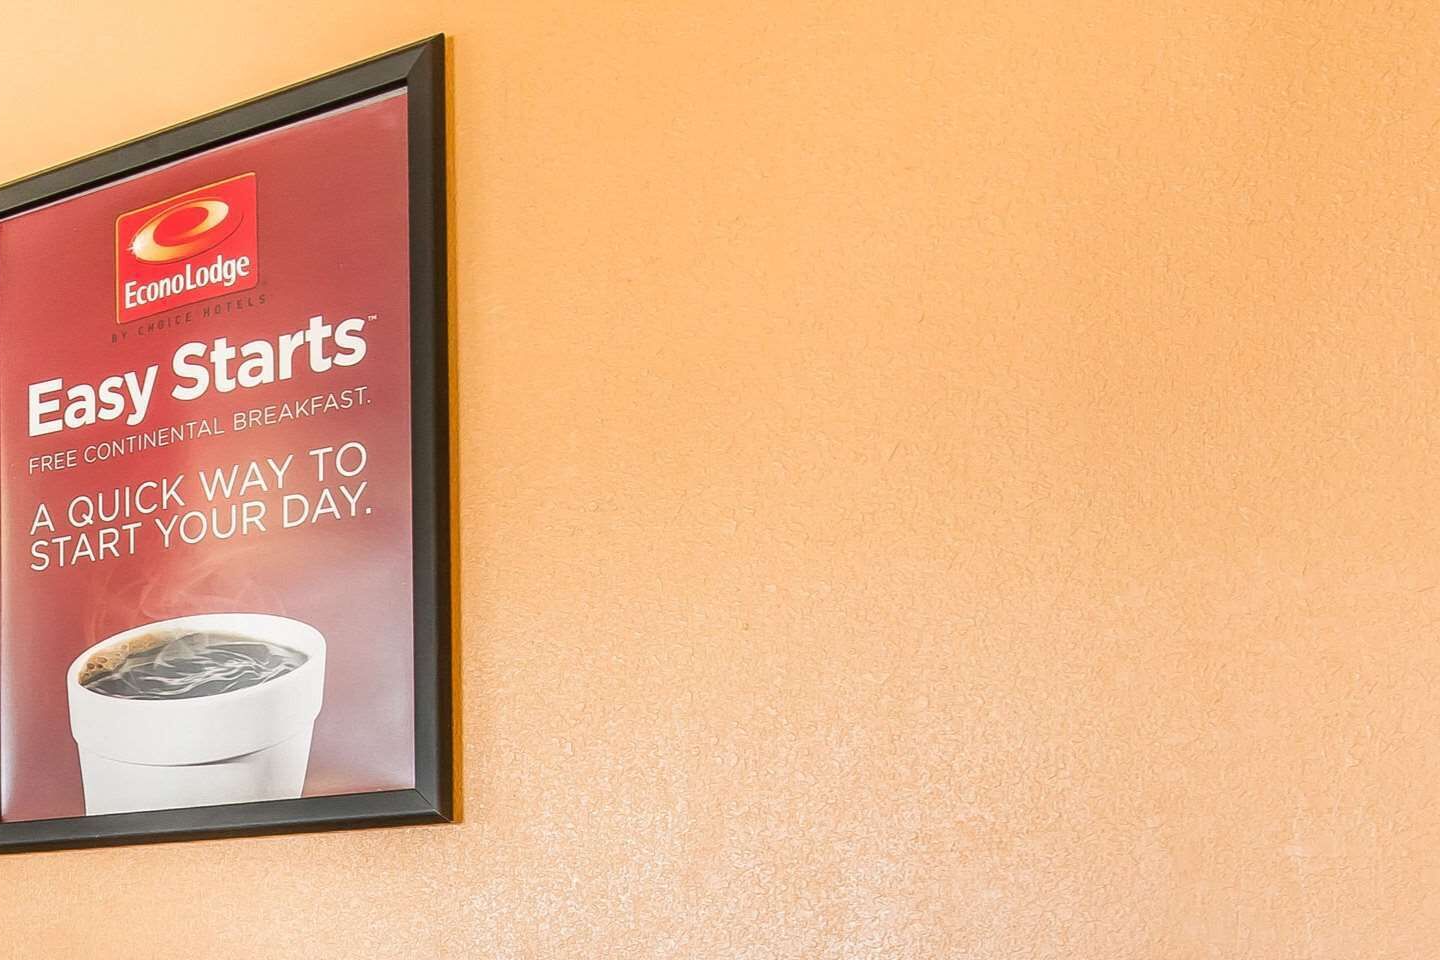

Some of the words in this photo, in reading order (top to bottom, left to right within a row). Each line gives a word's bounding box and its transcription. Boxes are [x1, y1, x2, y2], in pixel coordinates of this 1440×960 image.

[111, 330, 129, 344] BY
[137, 312, 193, 336] CHOICE
[202, 294, 267, 318] HOTELS
[124, 254, 251, 310] EconoLodge
[27, 364, 160, 438] Easy
[28, 449, 78, 475] FREE
[83, 418, 225, 464] CONTINENTAL
[233, 386, 372, 432] BREAKFAST.
[29, 502, 56, 536] A
[67, 474, 186, 529] QUICK
[198, 453, 295, 502] WAY
[308, 441, 368, 483] TO
[29, 521, 143, 572] START
[154, 500, 267, 549] YOUR
[282, 480, 373, 529] DAY.
